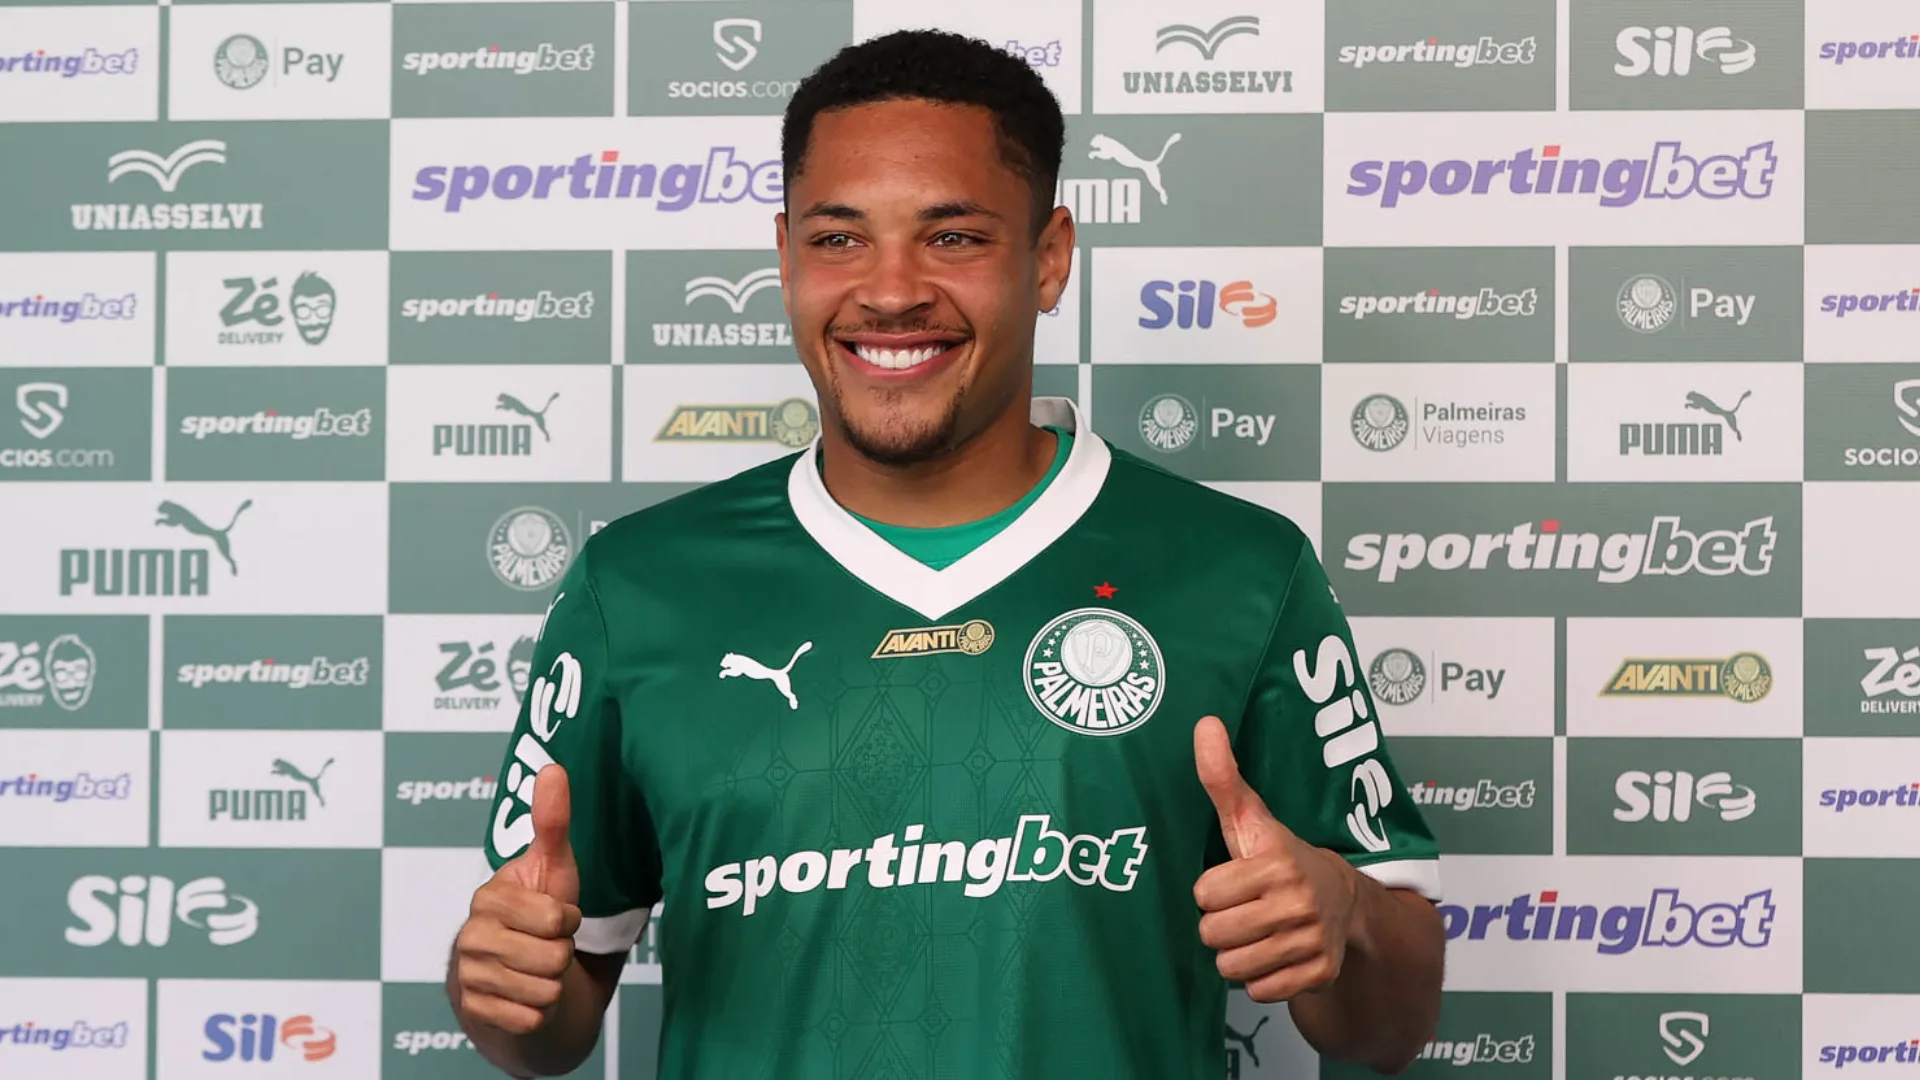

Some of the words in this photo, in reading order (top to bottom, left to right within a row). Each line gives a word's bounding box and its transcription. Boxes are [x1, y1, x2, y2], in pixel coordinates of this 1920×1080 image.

[284, 47, 344, 82] Pay
[403, 43, 595, 75] sportingbet
[1339, 36, 1536, 68] sportingbet
[1123, 71, 1292, 93] UNIASSELVI
[1347, 140, 1778, 208] sportingbet
[71, 203, 263, 230] UNIASSELVI
[1054, 178, 1141, 223] MA
[219, 277, 284, 327] Zé
[402, 291, 594, 322] sportingbet
[1340, 288, 1537, 319] sportingbet
[1620, 299, 1673, 330] PALMEIRAS
[1691, 288, 1755, 325] Pay
[218, 332, 283, 344] DELIVERY
[181, 408, 371, 439] sportingbet
[665, 411, 767, 437] AVANTI
[1212, 408, 1276, 445] Pay
[1424, 402, 1525, 421] Palmeiras
[433, 424, 531, 456] PUMA
[1142, 419, 1195, 449] PALMEIRAS
[1353, 417, 1408, 449] PALMEIRAS
[1423, 426, 1504, 448] Viagens
[1620, 423, 1722, 455] PUMA
[1845, 448, 1920, 465] SOCIO
[492, 543, 567, 586] PALMEIRAS
[1345, 516, 1777, 583] sportingbet
[60, 549, 209, 596] PUMA
[881, 630, 956, 653] AVANTI
[178, 657, 369, 688] sportingbet
[435, 641, 501, 692] Zé
[1441, 662, 1505, 699] Pay
[1612, 664, 1717, 691] AVANTI
[1861, 647, 1920, 697] Zé
[434, 697, 500, 709] DELIVERY
[1033, 662, 1156, 728] PALMEIRAS
[1372, 673, 1425, 704] PALMEIRAS
[209, 789, 306, 821] PUMA
[396, 775, 499, 805] sporti
[705, 815, 1148, 916] sportingbet
